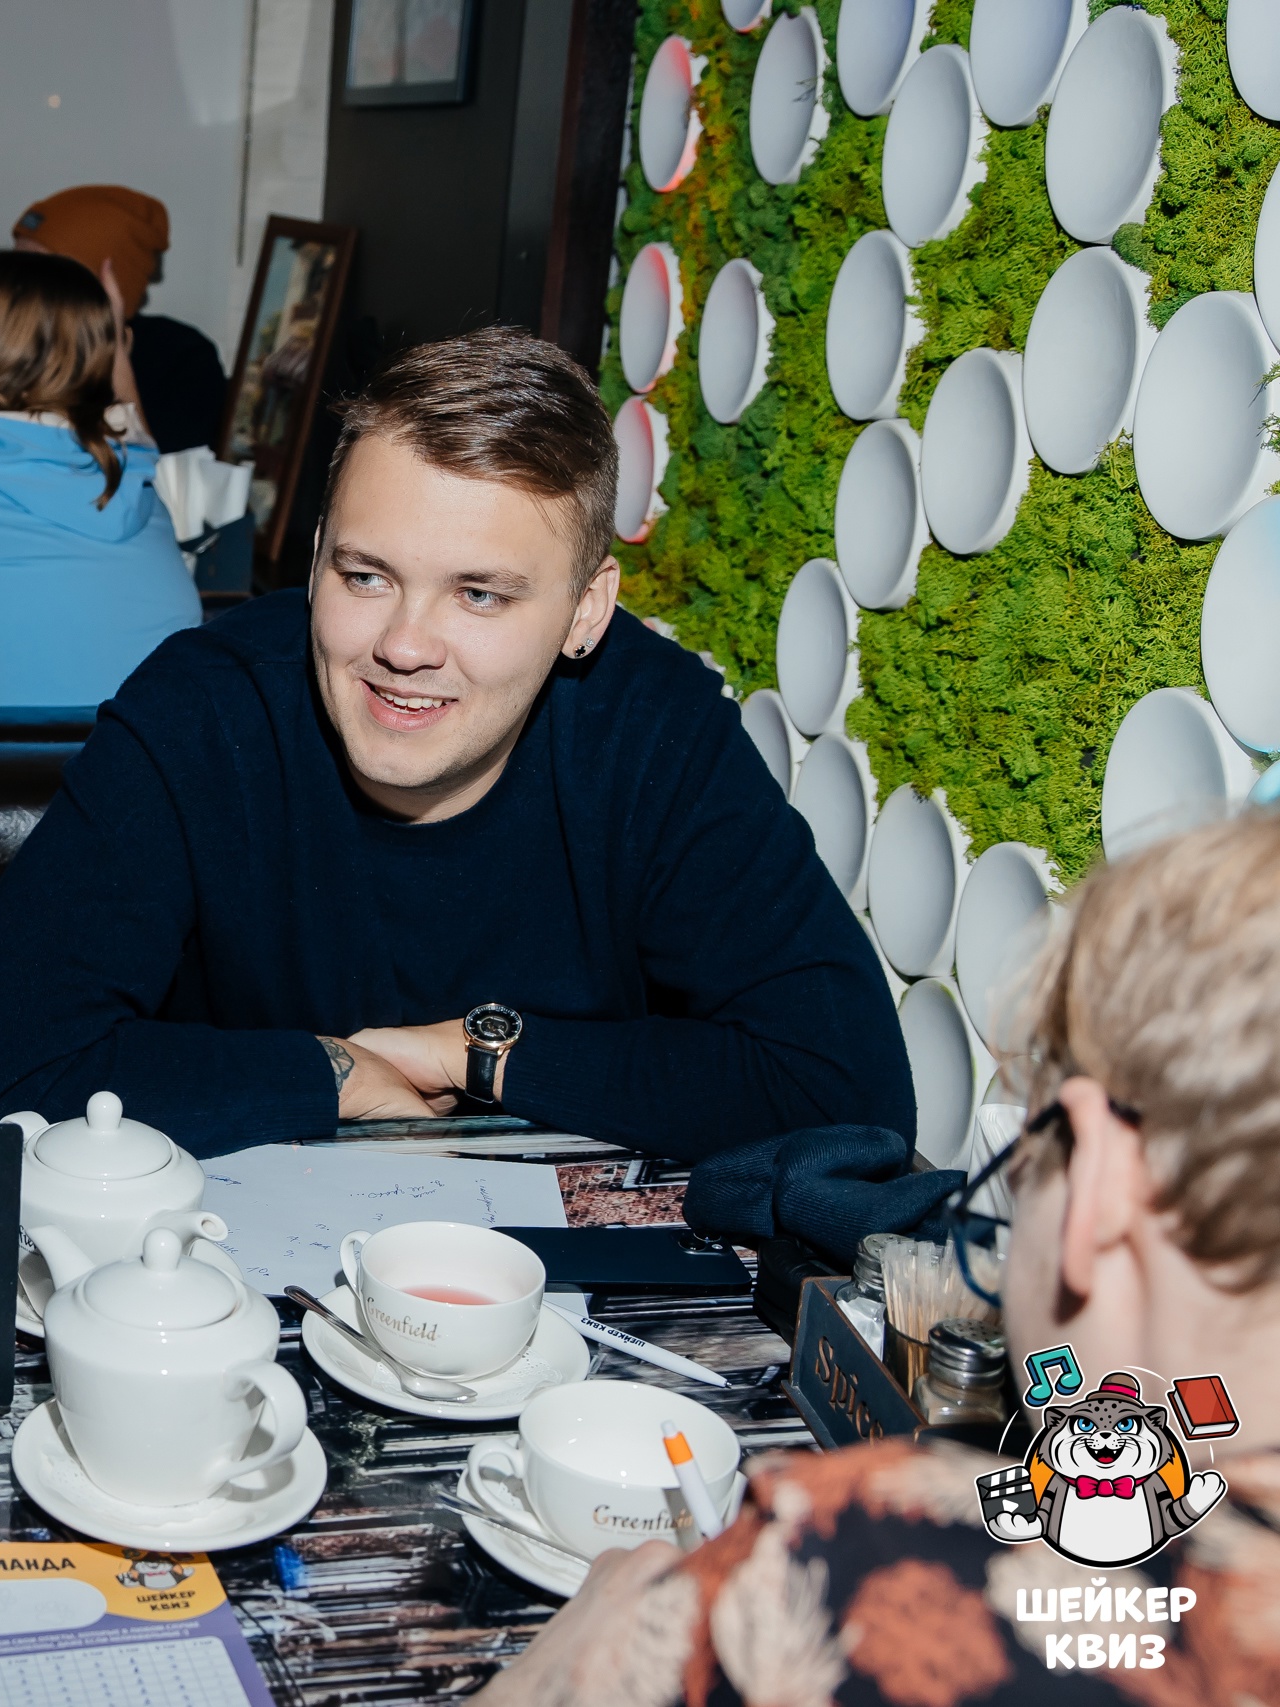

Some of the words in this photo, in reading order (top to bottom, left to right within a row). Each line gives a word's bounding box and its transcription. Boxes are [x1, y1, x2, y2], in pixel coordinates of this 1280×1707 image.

[366, 1296, 439, 1342] Greenfield
[580, 1317, 607, 1332] КВИЗ
[607, 1328, 646, 1348] ШЕЙКЕР
[136, 1588, 197, 1604] ШЕЙКЕР
[150, 1600, 191, 1612] КВИЗ
